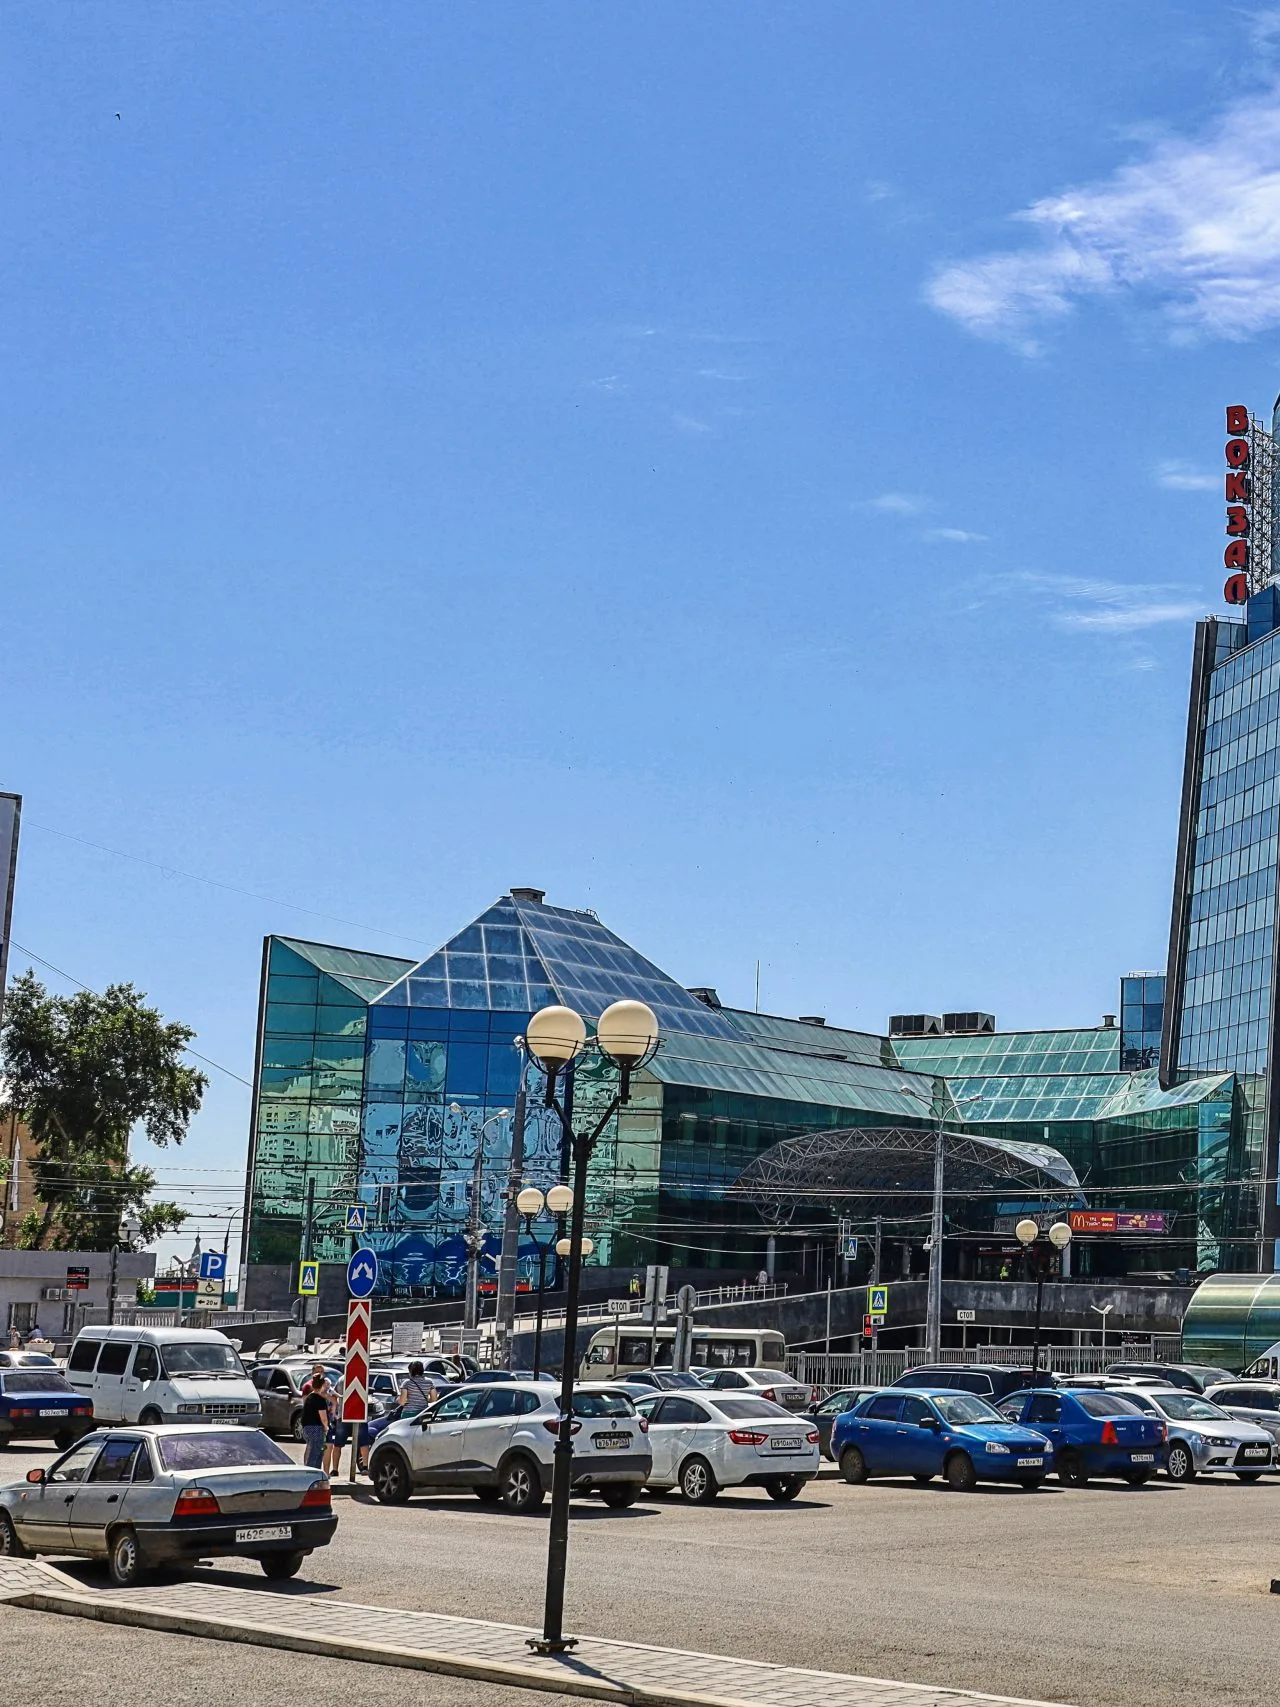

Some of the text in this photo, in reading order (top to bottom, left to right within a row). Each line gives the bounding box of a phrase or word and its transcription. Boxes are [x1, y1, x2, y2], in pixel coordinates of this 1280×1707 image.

[1224, 405, 1248, 604] ВОКЗАЛ
[206, 1255, 222, 1276] P
[611, 1301, 627, 1310] СТОП
[960, 1311, 974, 1319] СТОП
